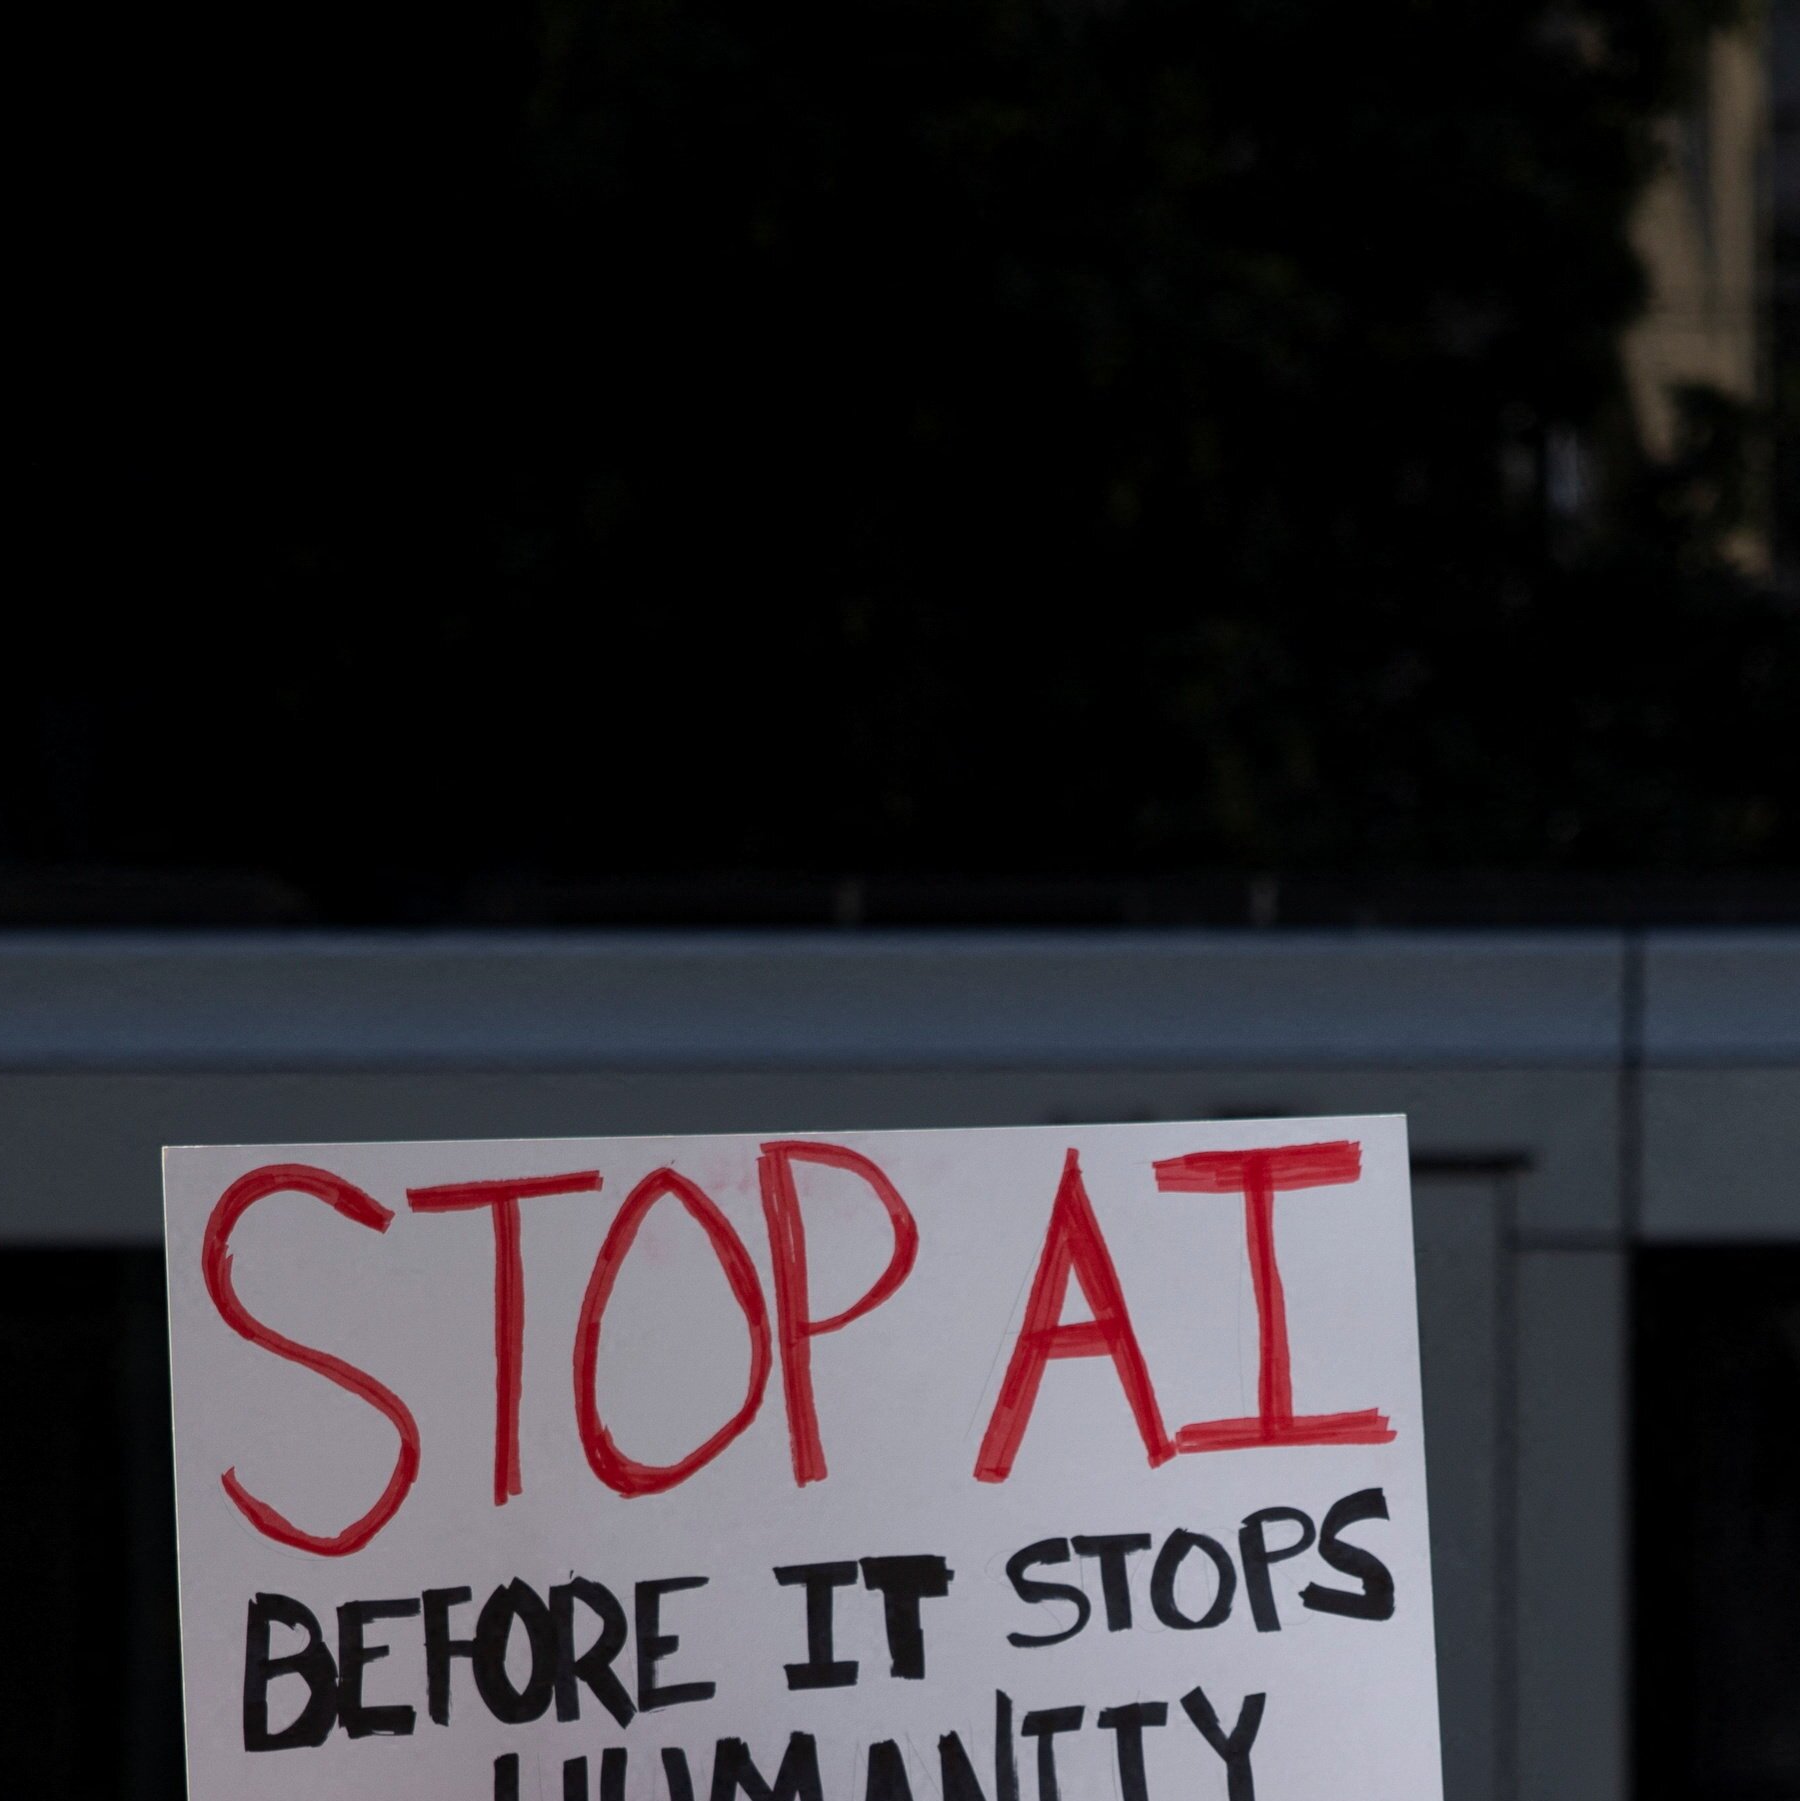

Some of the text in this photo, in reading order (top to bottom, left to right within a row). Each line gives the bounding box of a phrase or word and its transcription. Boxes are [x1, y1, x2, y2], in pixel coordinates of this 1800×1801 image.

[201, 1139, 1397, 1557] STOP AI
[242, 1487, 1395, 1753] BEFORE IT STOPS
